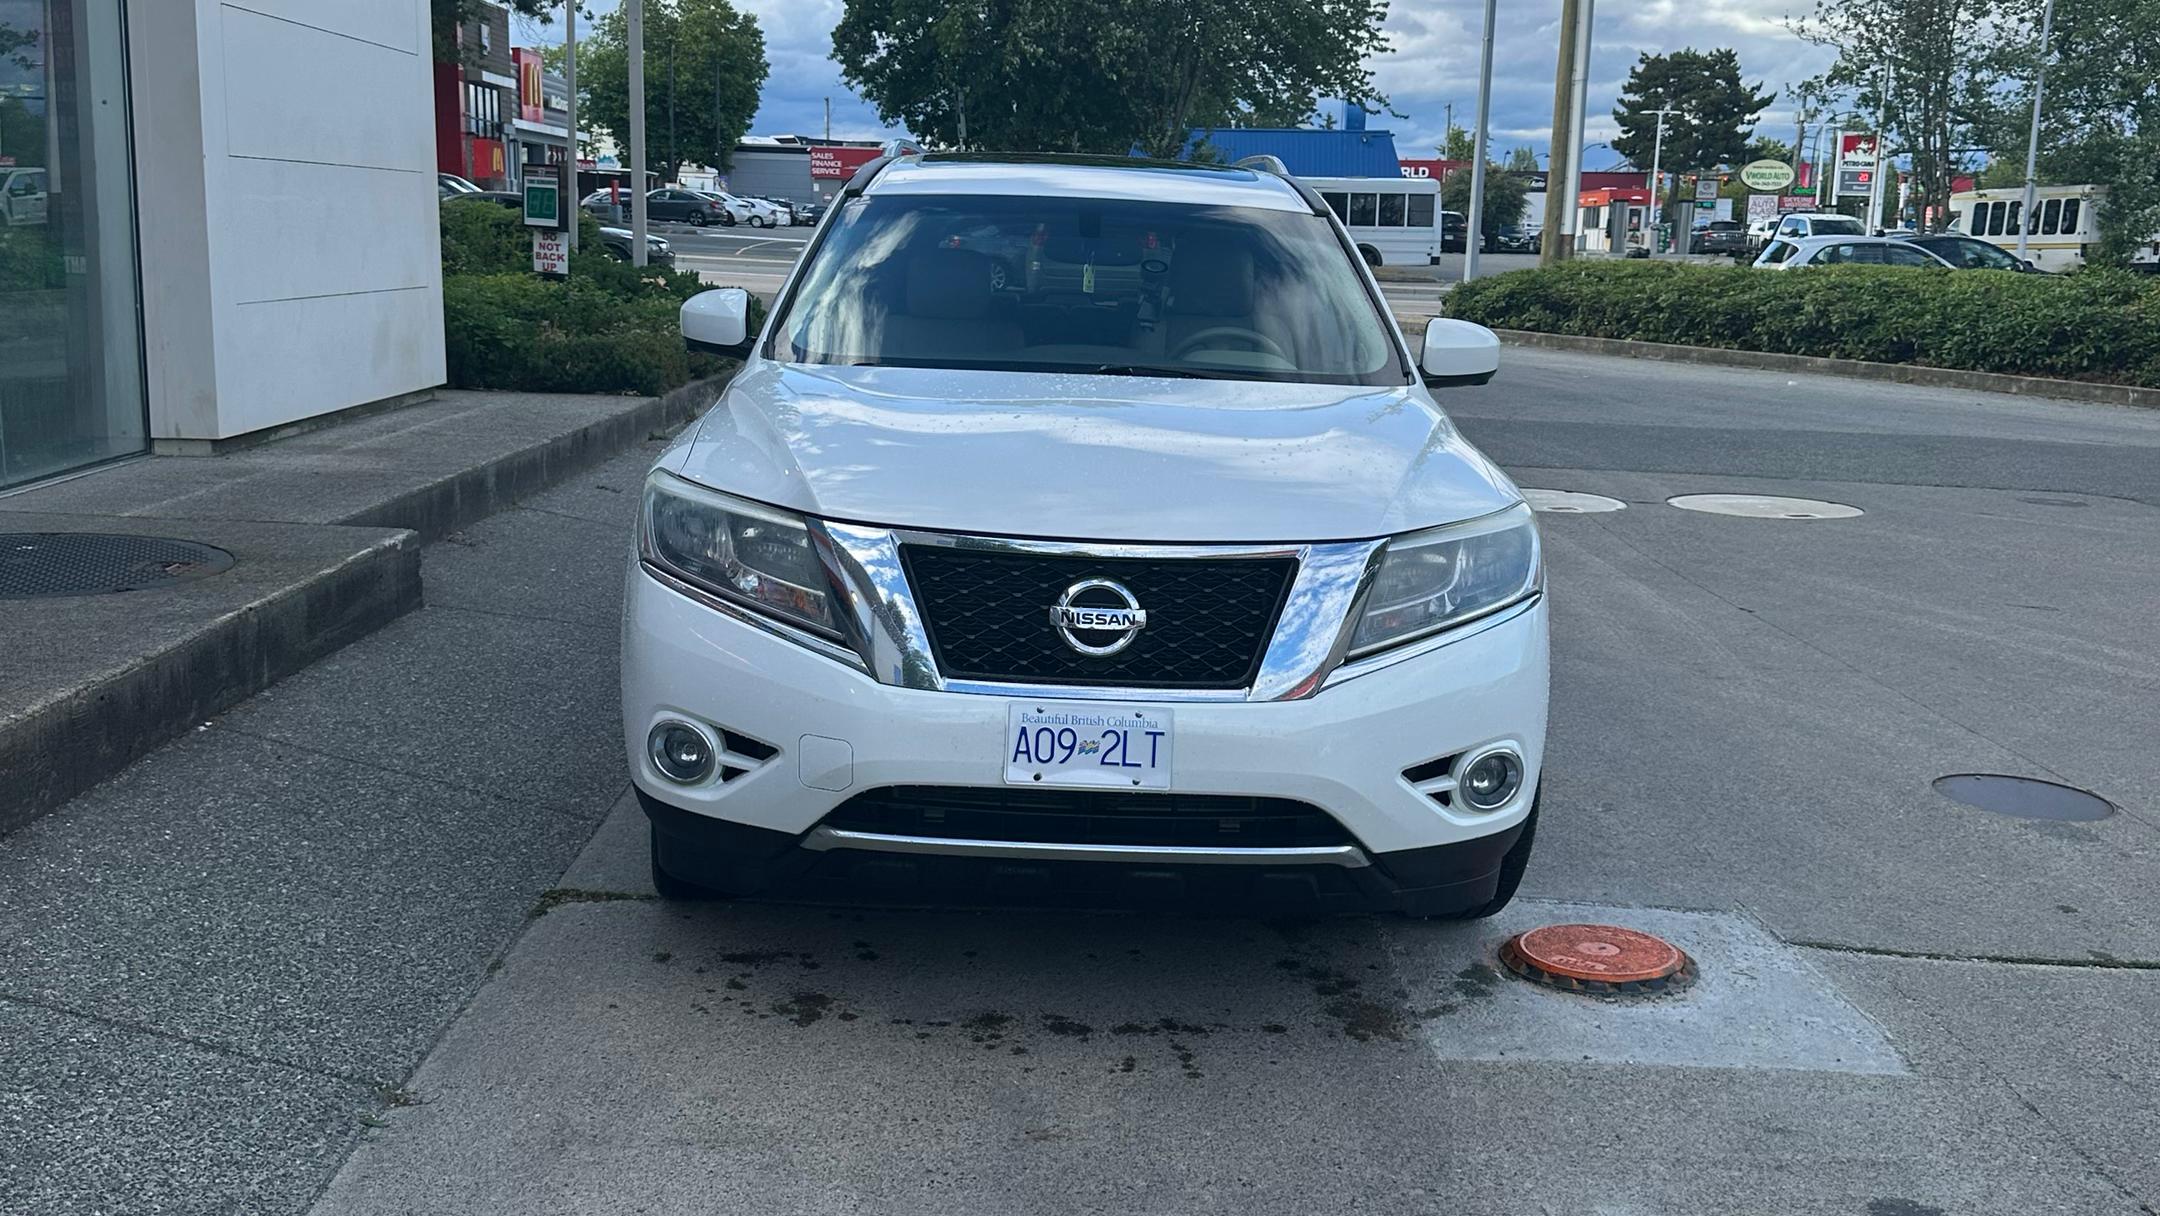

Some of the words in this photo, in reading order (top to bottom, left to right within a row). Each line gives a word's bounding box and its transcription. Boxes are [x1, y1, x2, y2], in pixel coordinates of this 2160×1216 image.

[811, 152, 834, 160] SALES
[811, 160, 842, 168] FINANCE
[1400, 166, 1430, 178] RLD
[1773, 172, 1790, 180] AUTO
[1751, 200, 1776, 208] AUTO
[1748, 207, 1776, 215] GLASS
[542, 232, 557, 242] DO
[538, 242, 561, 252] NOT
[535, 251, 565, 262] BACK
[541, 262, 557, 272] UP
[1060, 610, 1136, 626] NISSAN
[1022, 712, 1069, 726] Beautiful
[1071, 715, 1104, 727] British
[1106, 717, 1158, 729] Columbia
[1012, 726, 1078, 764] A09
[1100, 729, 1166, 768] 2LT
